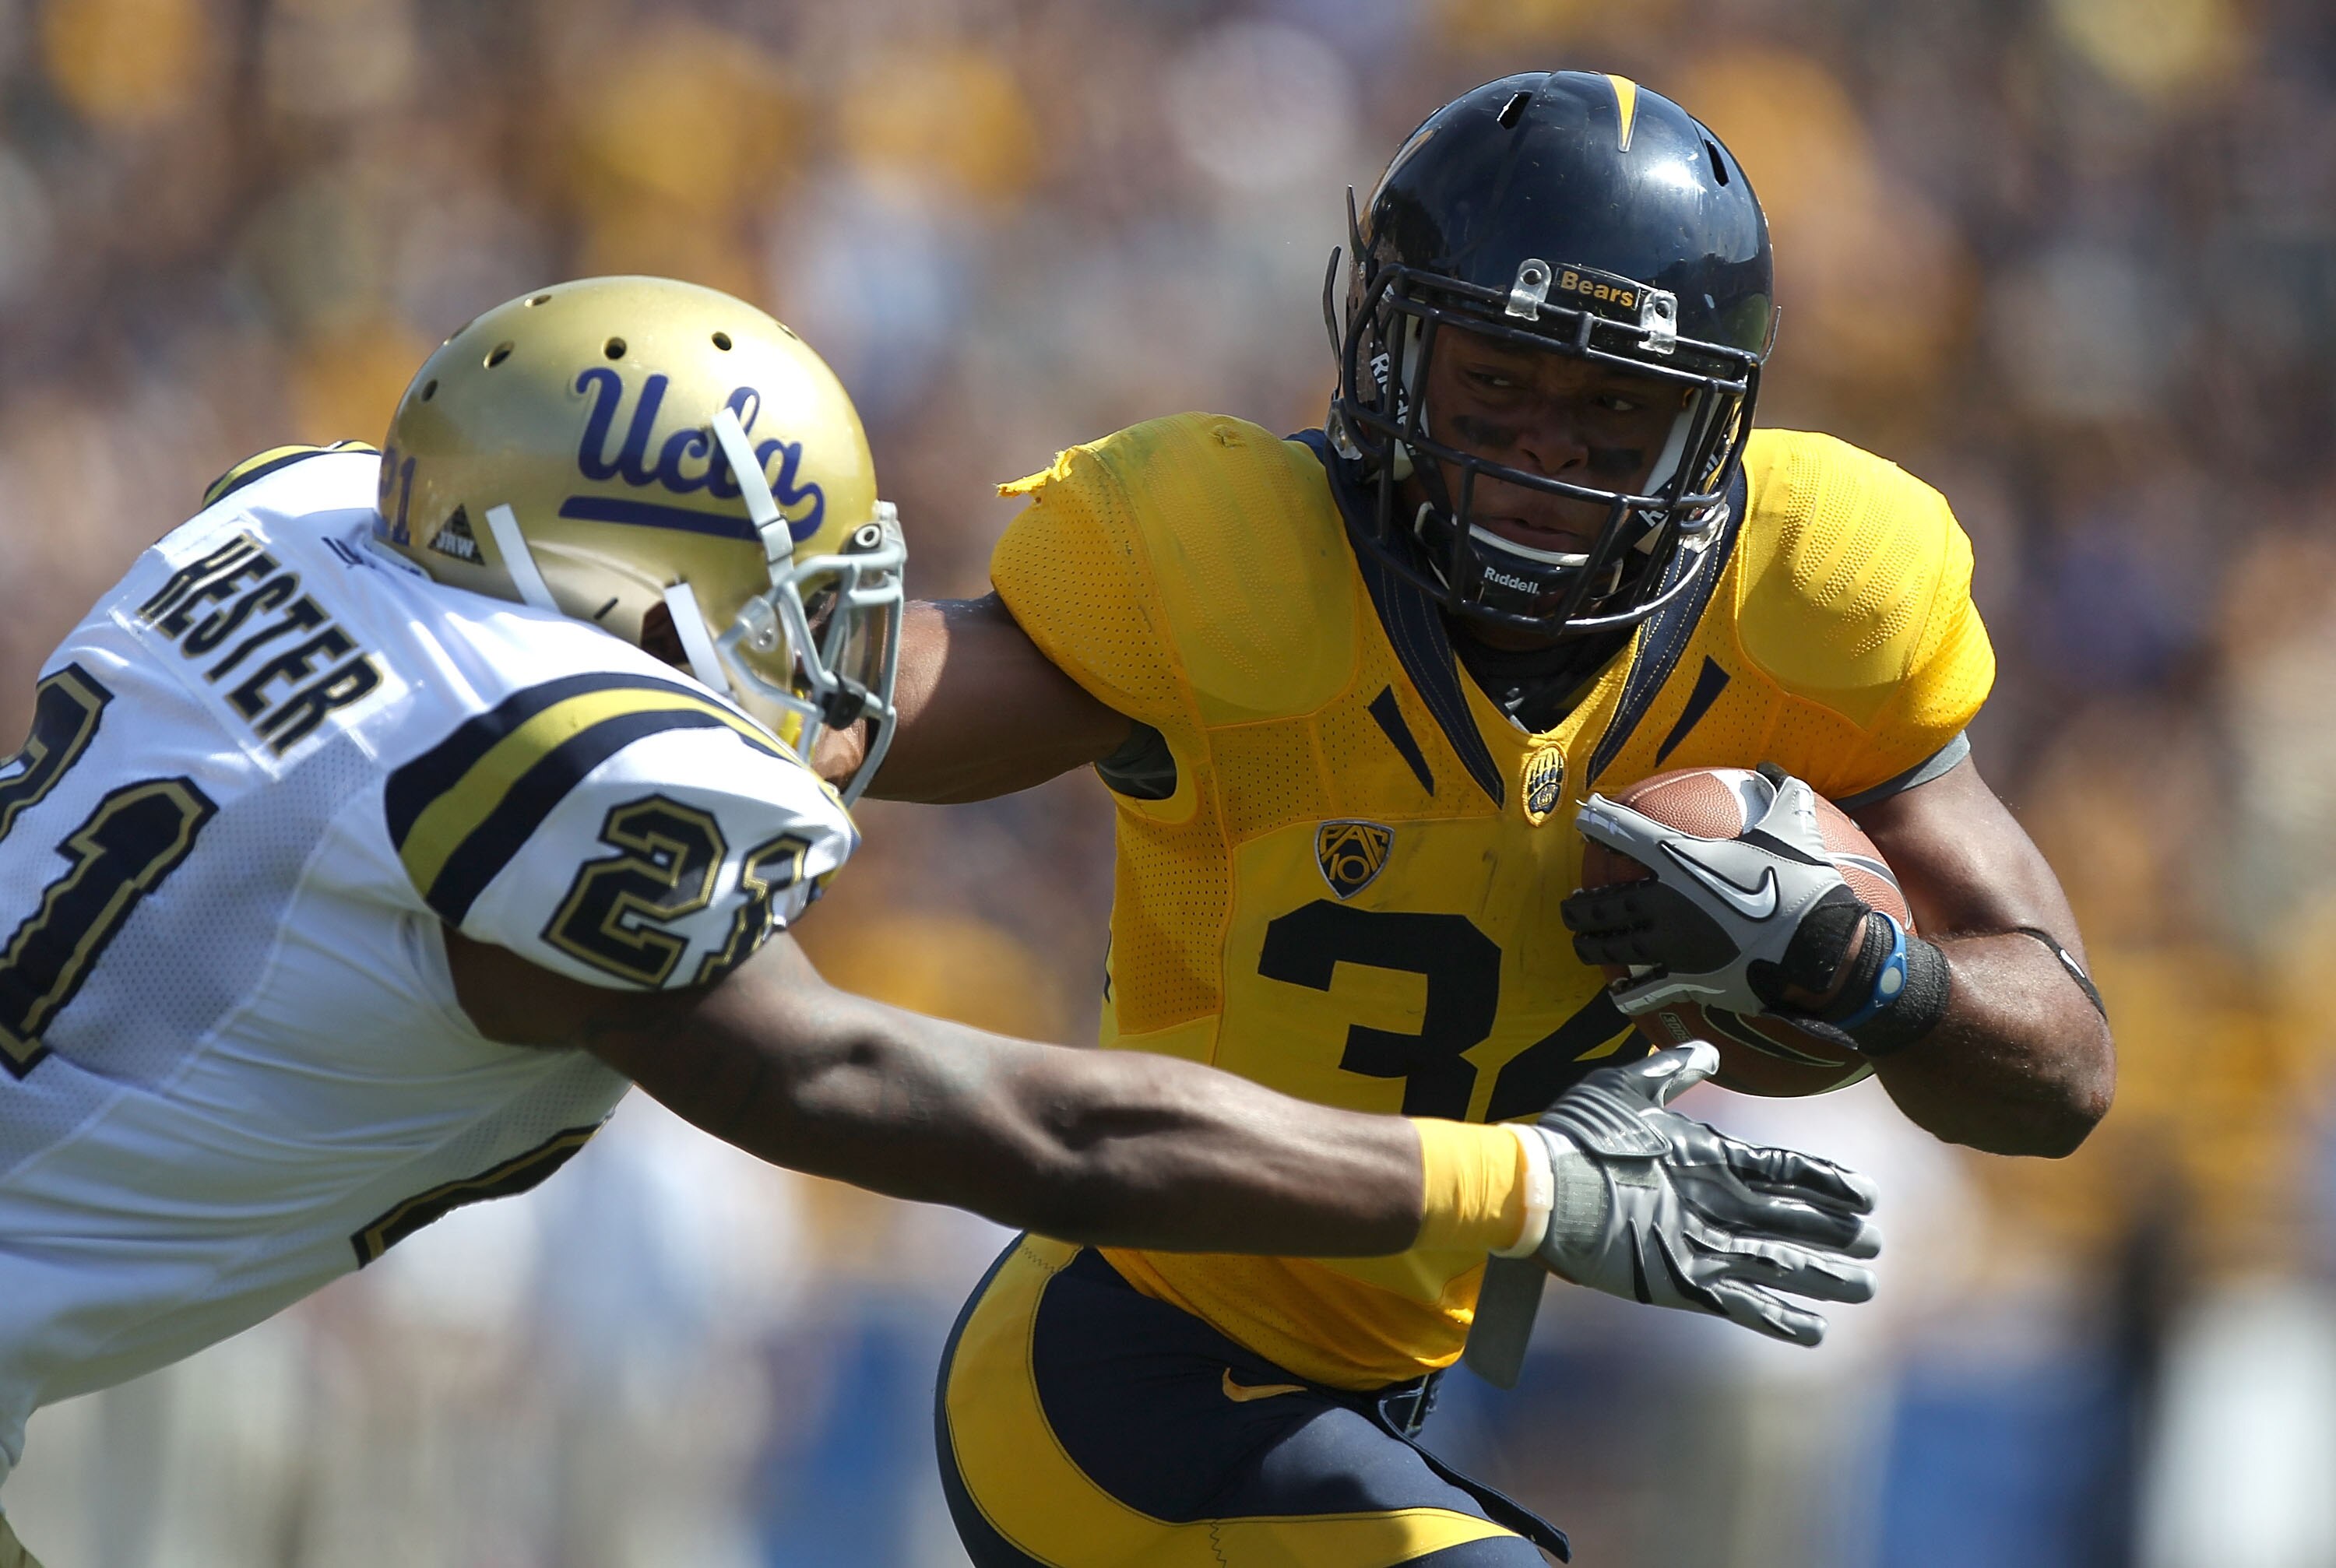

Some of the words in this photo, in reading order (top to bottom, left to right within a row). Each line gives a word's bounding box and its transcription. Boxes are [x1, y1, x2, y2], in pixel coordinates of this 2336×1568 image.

[1560, 270, 1634, 307] Bears
[575, 367, 825, 543] Ucla
[1484, 566, 1539, 595] Riddell
[135, 533, 385, 760] HESTER
[1320, 825, 1388, 872] PAC
[1329, 853, 1370, 884] 10
[540, 793, 812, 993] 21
